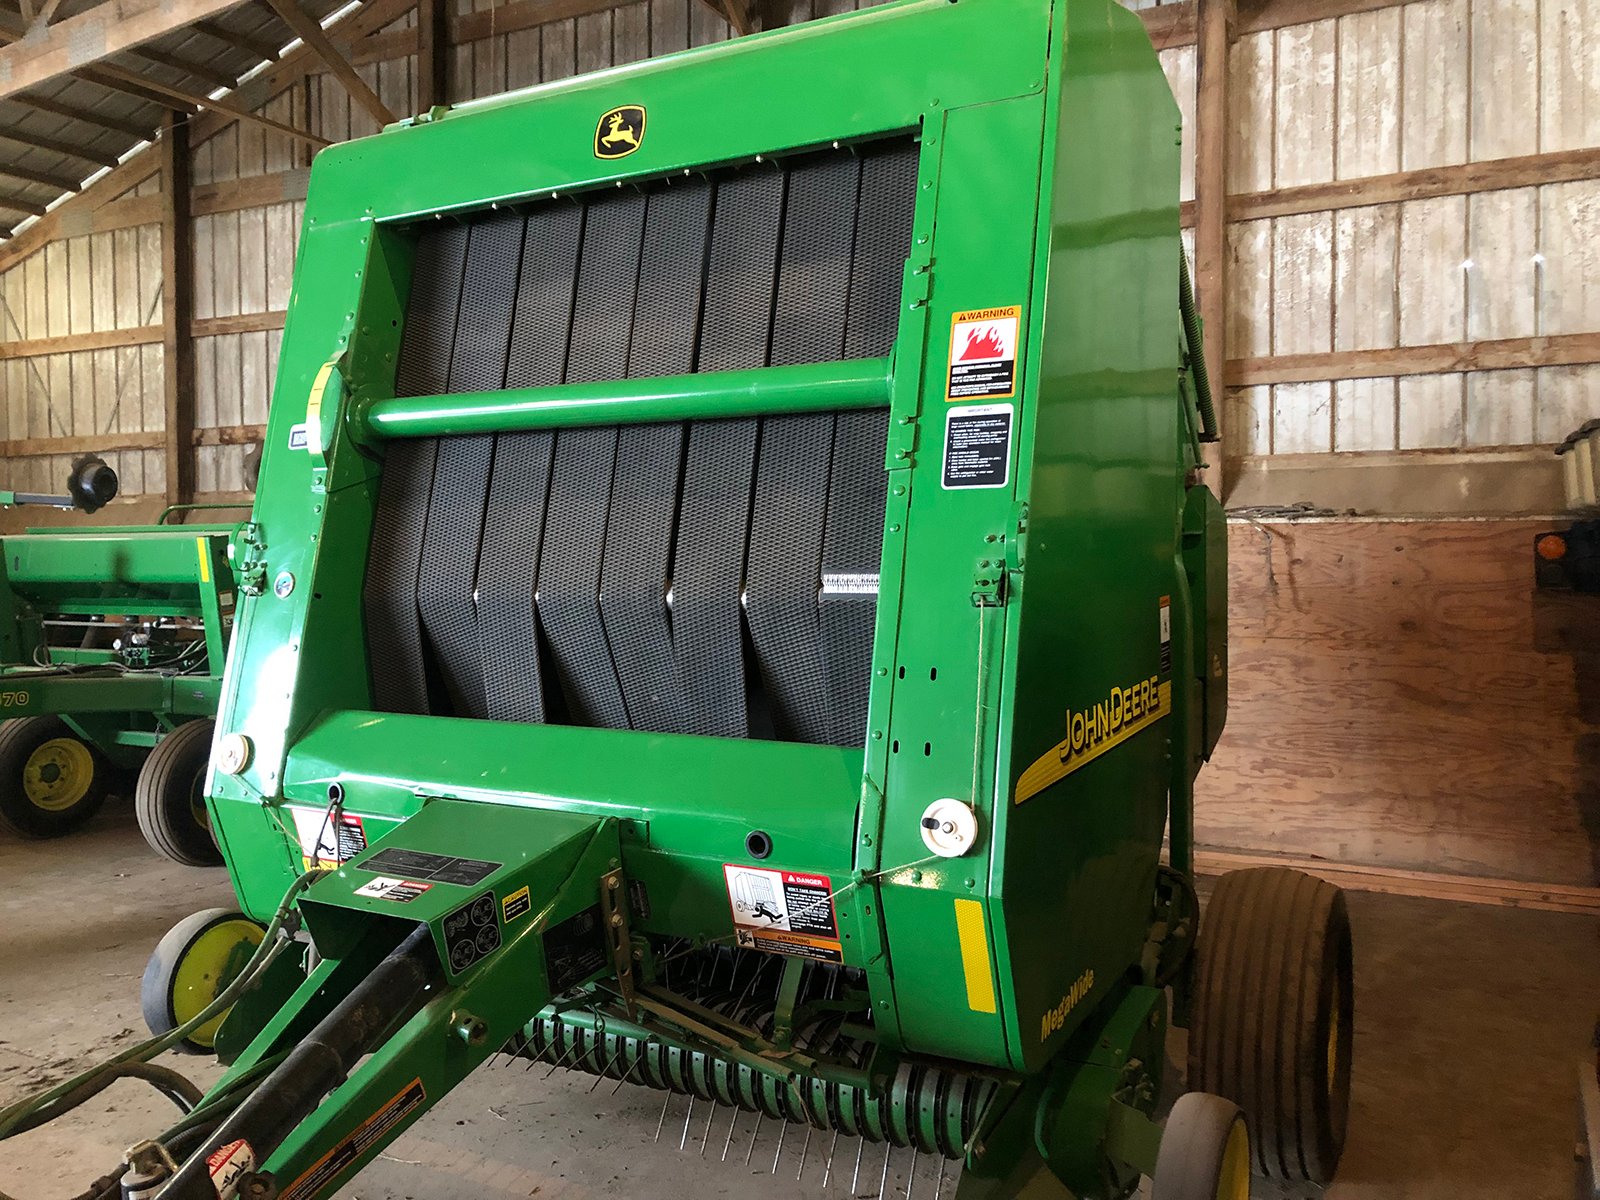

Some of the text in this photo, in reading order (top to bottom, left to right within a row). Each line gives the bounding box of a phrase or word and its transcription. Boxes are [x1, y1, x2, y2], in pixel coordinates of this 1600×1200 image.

[967, 307, 1014, 321] WARNING
[0, 691, 29, 706] 70
[1060, 674, 1160, 760] JOHN DEERE
[796, 877, 823, 885] DANGER
[781, 936, 811, 945] WARNING
[1041, 968, 1094, 1043] MegaWide
